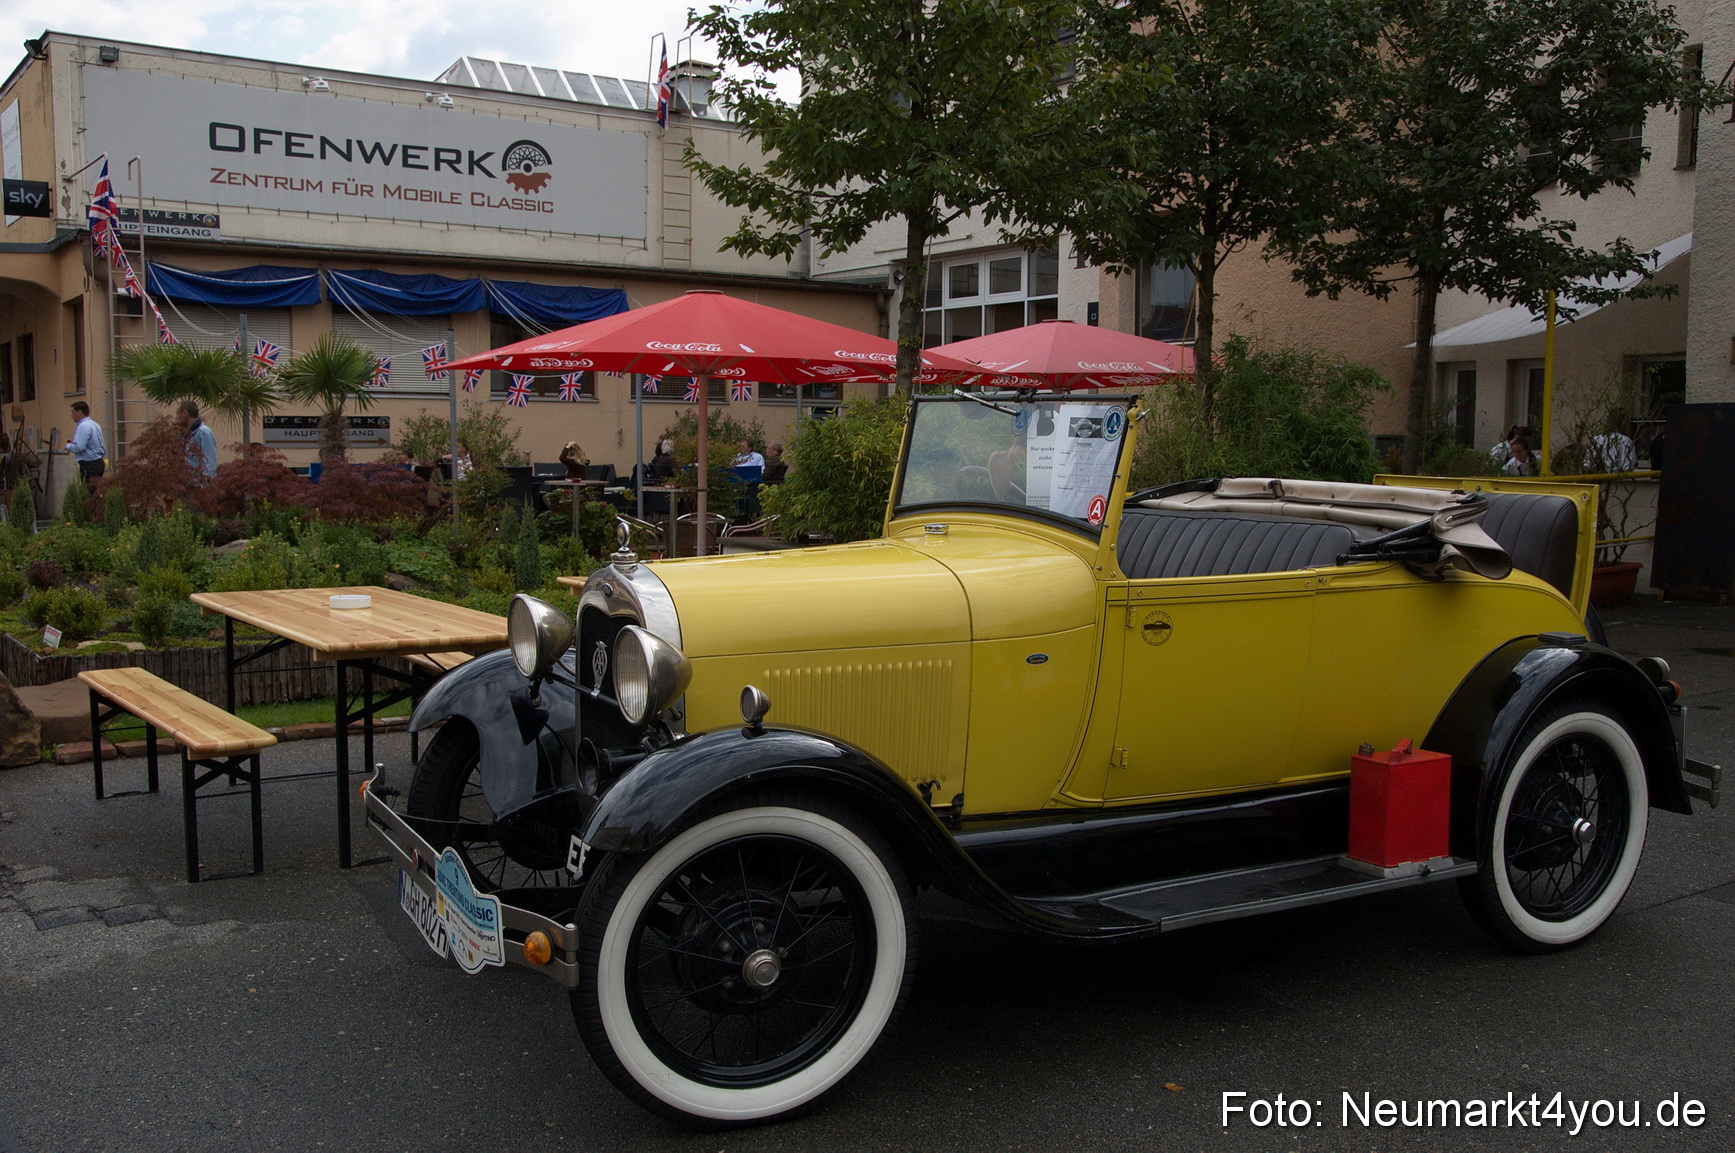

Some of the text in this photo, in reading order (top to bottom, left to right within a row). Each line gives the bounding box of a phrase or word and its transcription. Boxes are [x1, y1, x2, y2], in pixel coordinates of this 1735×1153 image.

[209, 121, 497, 180] OFENWERK
[9, 187, 44, 208] sky
[210, 168, 323, 193] ZENTRUM
[383, 184, 463, 205] MOBILE
[470, 192, 554, 213] CLASSIC
[464, 897, 494, 922] CLASSIC
